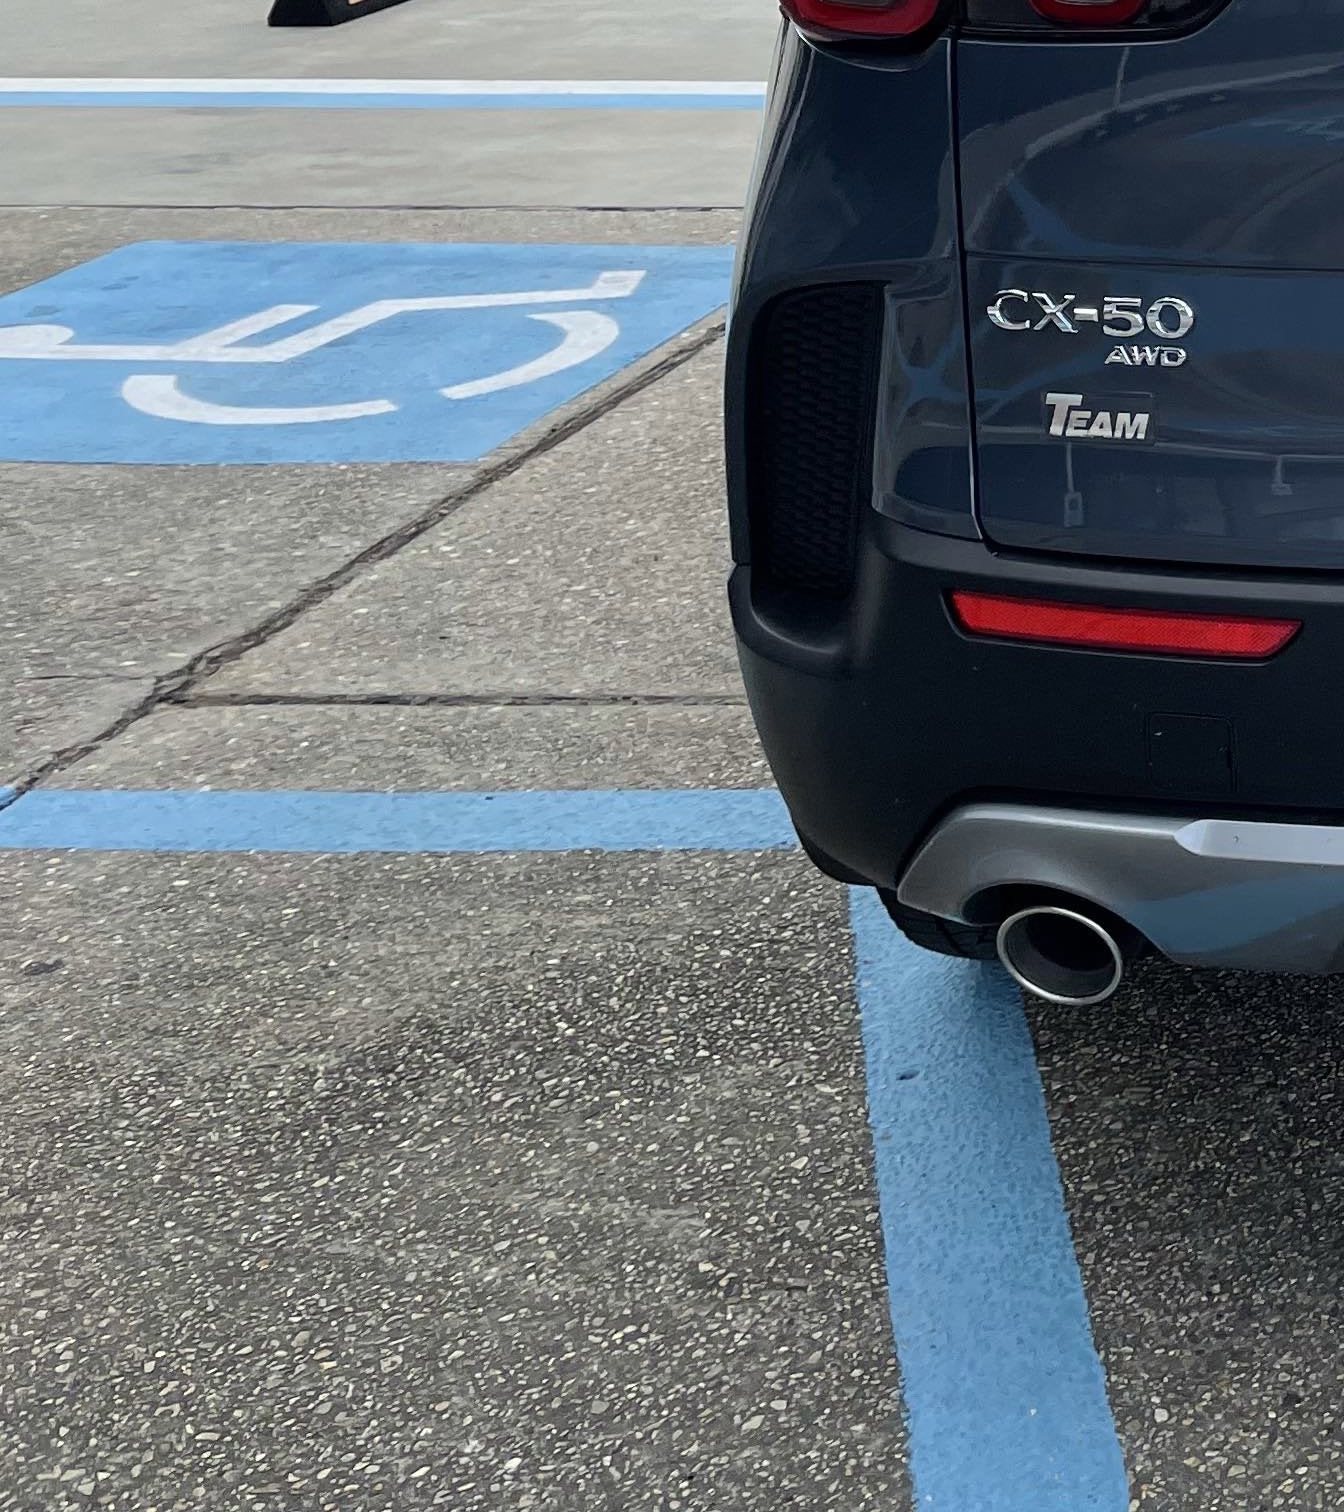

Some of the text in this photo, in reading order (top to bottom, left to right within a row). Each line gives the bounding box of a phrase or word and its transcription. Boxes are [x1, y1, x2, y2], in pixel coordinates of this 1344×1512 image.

[987, 289, 1195, 339] CX-50
[1104, 345, 1188, 367] AWD
[1046, 392, 1150, 439] TEAM
